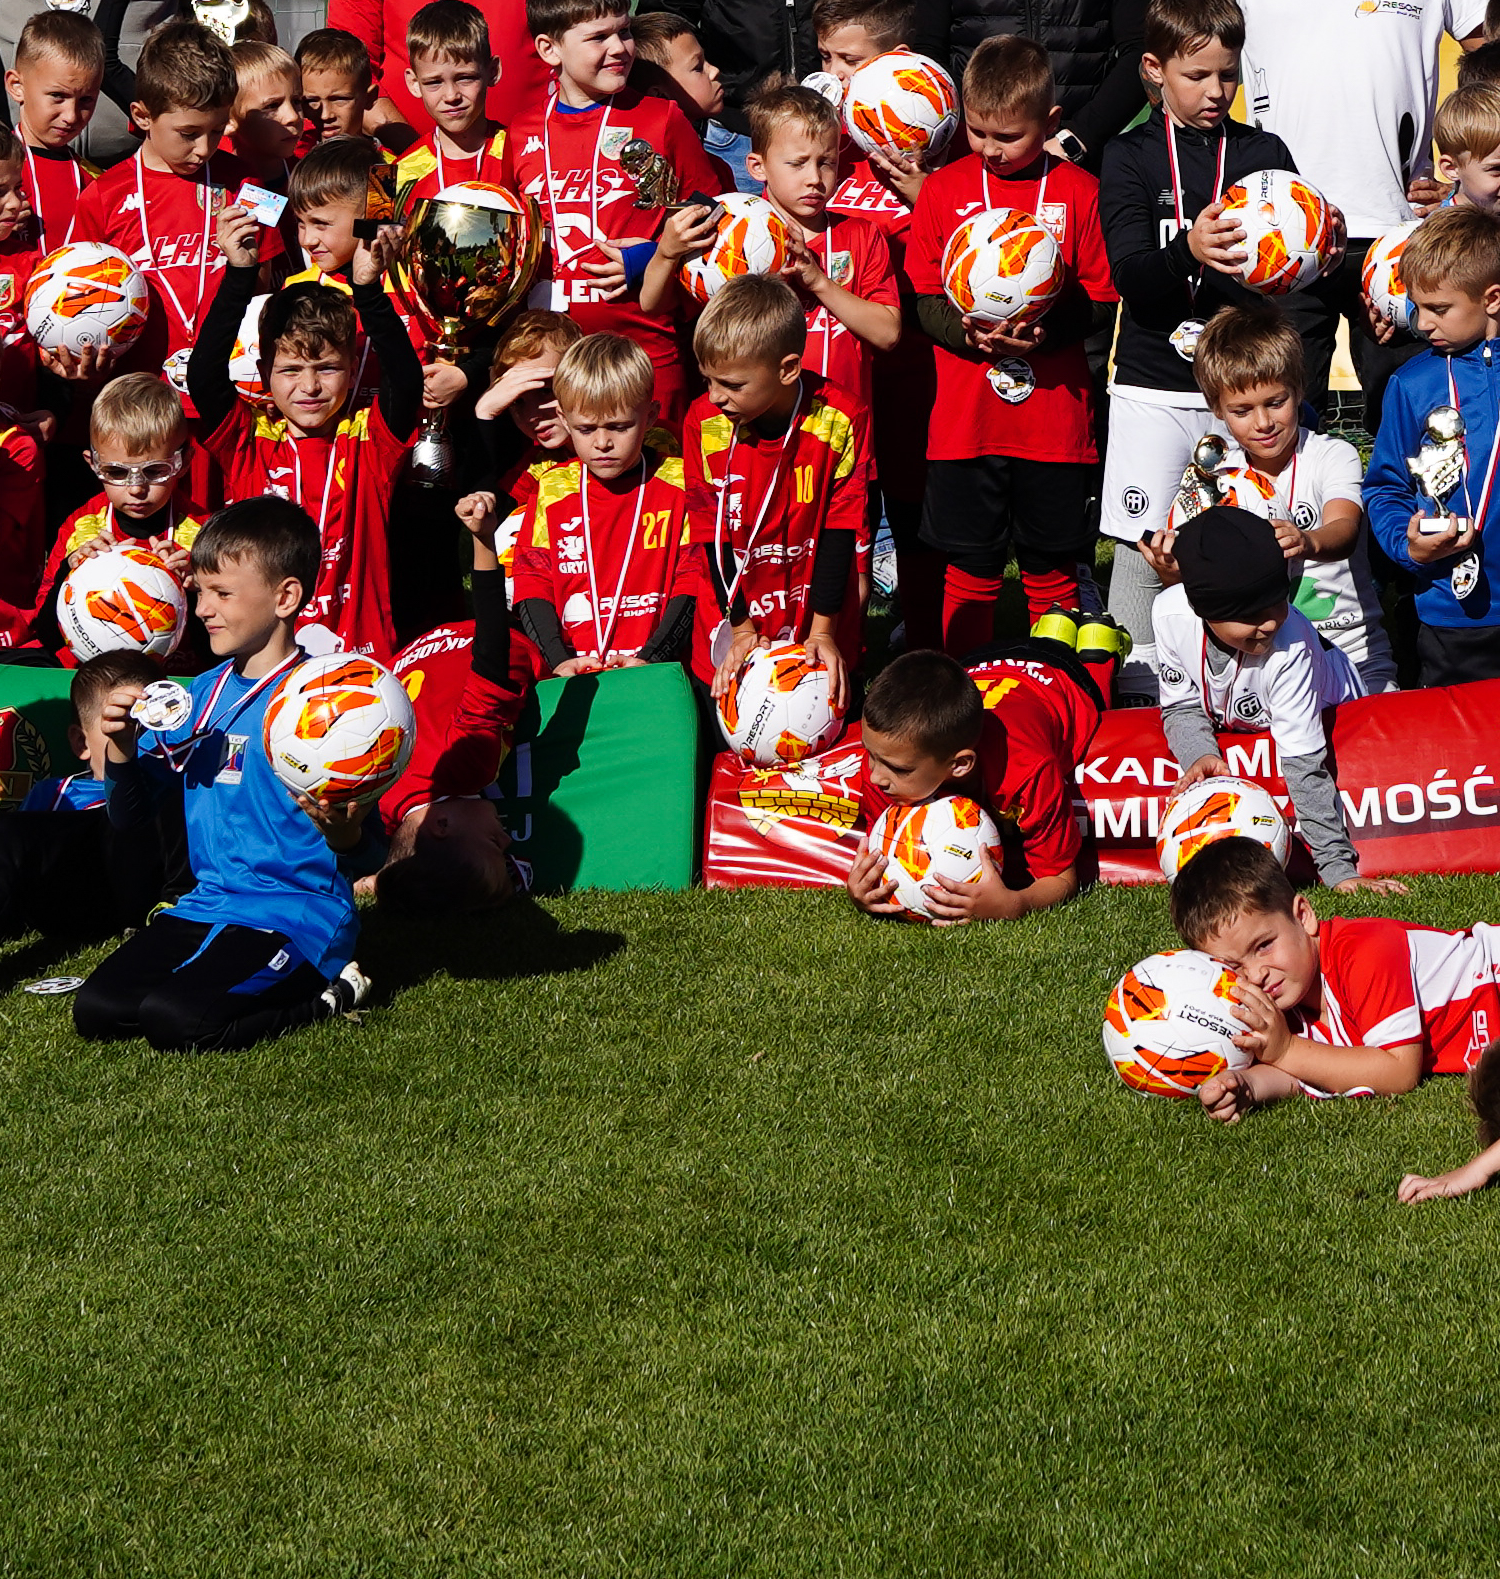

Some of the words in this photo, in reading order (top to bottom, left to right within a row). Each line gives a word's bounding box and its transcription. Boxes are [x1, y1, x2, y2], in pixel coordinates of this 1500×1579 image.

[1382, 0, 1423, 15] RESORT
[794, 464, 814, 504] 10
[641, 510, 672, 549] 27
[748, 584, 812, 620] ASTE
[69, 606, 102, 656] RESORT
[745, 695, 772, 745] RESORT
[1078, 798, 1166, 840] GMI
[1179, 1009, 1236, 1041] RESORT
